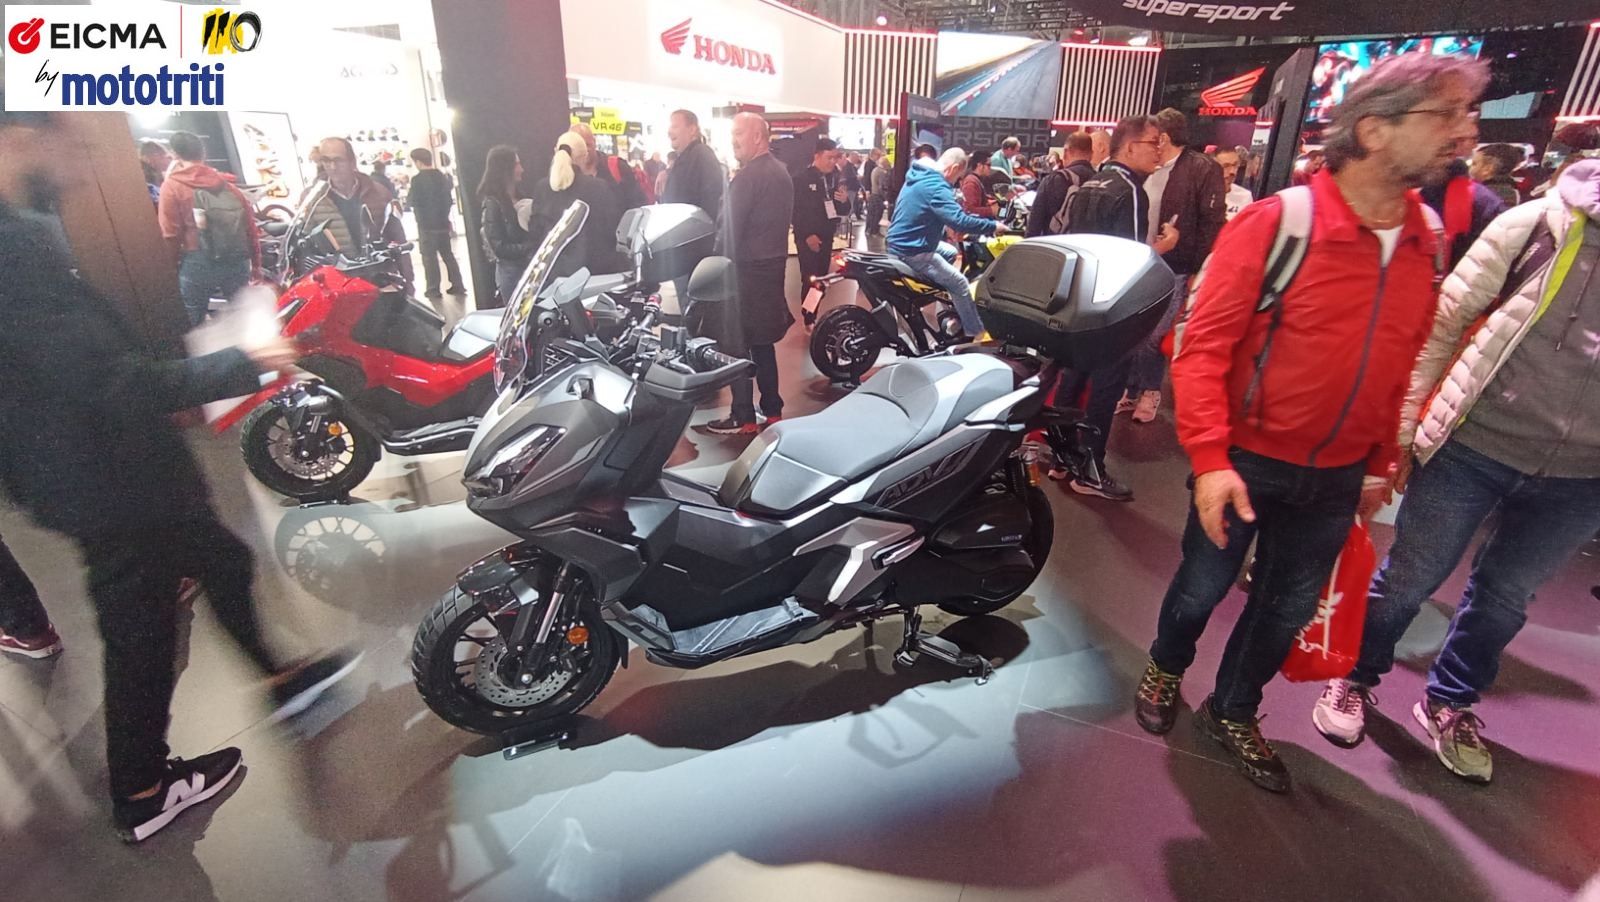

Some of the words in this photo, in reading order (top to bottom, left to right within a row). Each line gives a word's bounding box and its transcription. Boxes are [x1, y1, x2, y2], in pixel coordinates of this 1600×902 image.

[1122, 0, 1296, 24] supersport
[693, 34, 776, 75] HONDA
[1198, 106, 1258, 116] HONDA
